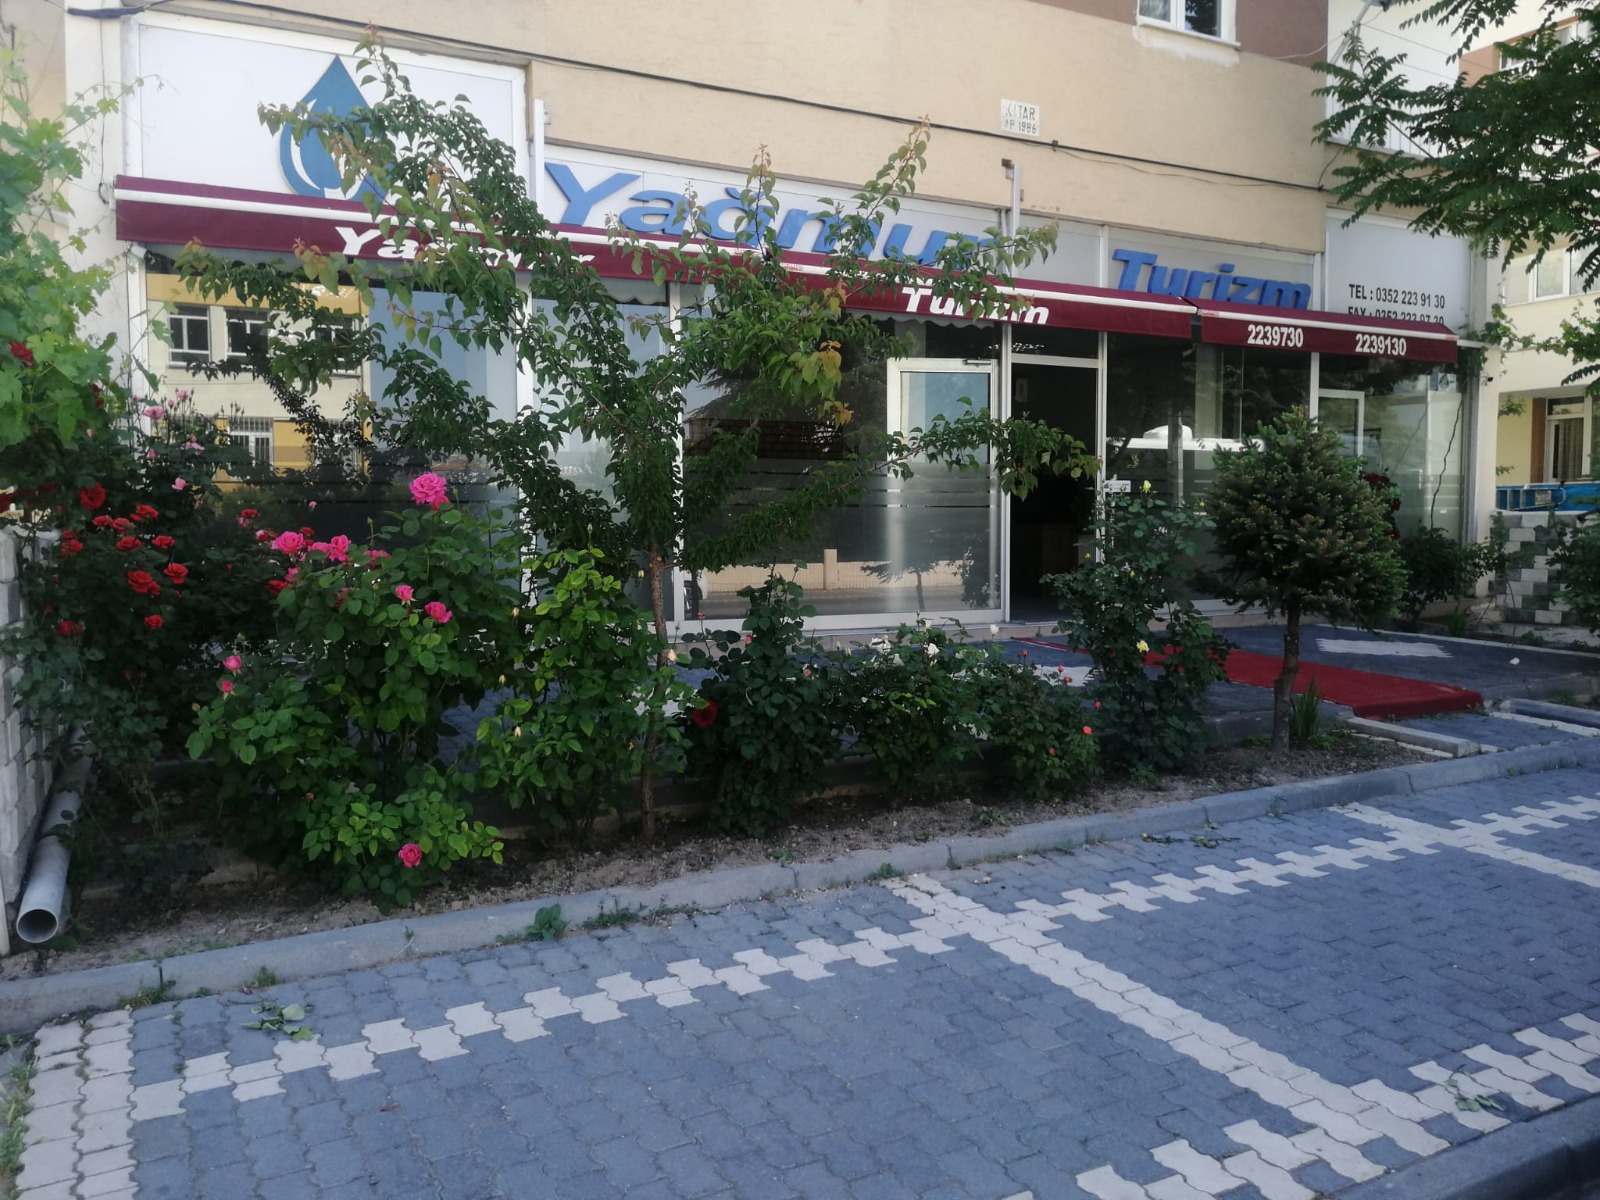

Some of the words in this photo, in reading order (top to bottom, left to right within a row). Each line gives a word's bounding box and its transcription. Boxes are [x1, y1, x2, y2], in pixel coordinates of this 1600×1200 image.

[1112, 248, 1311, 310] Turizm
[902, 286, 1050, 325] Turzm
[1348, 284, 1367, 299] TEL
[1376, 287, 1399, 304] 0352
[1401, 290, 1418, 306] 223
[1420, 292, 1431, 307] 91
[1434, 294, 1445, 309] 30
[1347, 306, 1366, 317] FAX
[1247, 324, 1304, 348] 2239730
[1355, 333, 1407, 356] 2239130
